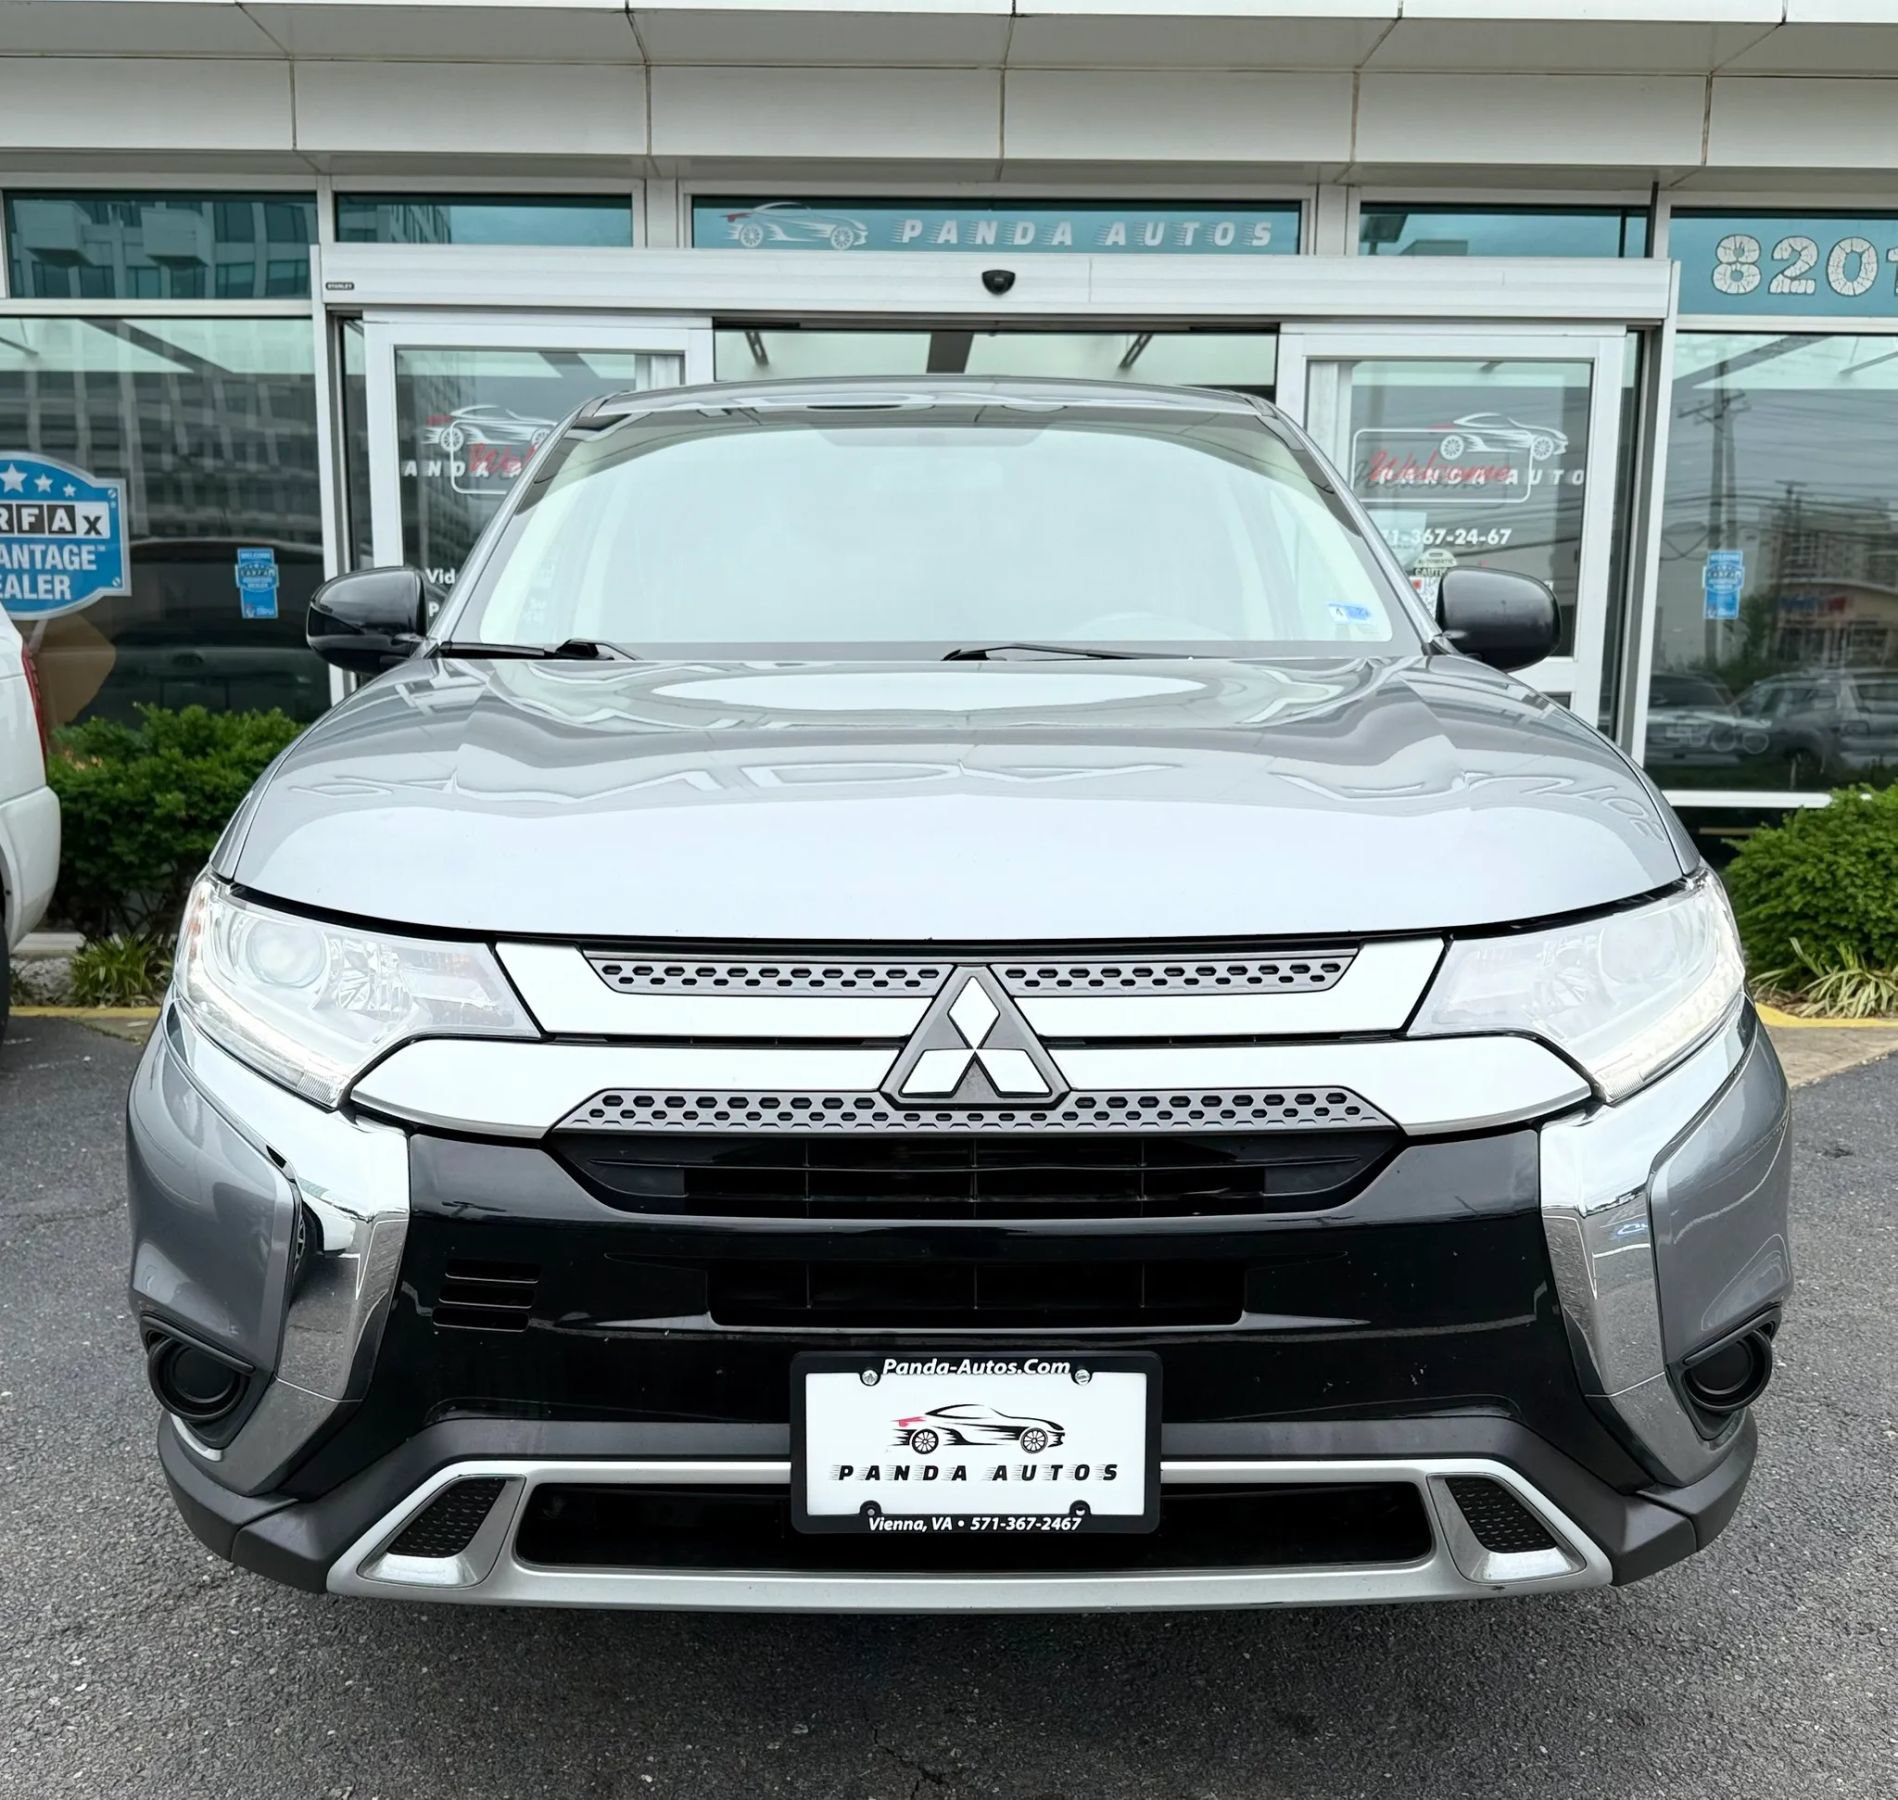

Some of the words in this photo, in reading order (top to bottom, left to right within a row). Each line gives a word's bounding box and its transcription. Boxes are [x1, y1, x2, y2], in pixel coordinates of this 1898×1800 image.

[892, 218, 1073, 247] PANDA
[1095, 220, 1273, 247] AUTOS
[883, 1358, 1071, 1376] Panda-Autos.Com
[832, 1464, 967, 1481] PANDA
[985, 1464, 1118, 1481] AUTOS
[868, 1517, 927, 1532] Vienna,
[931, 1517, 952, 1530] VA
[970, 1517, 1082, 1531] 571-367-2467
